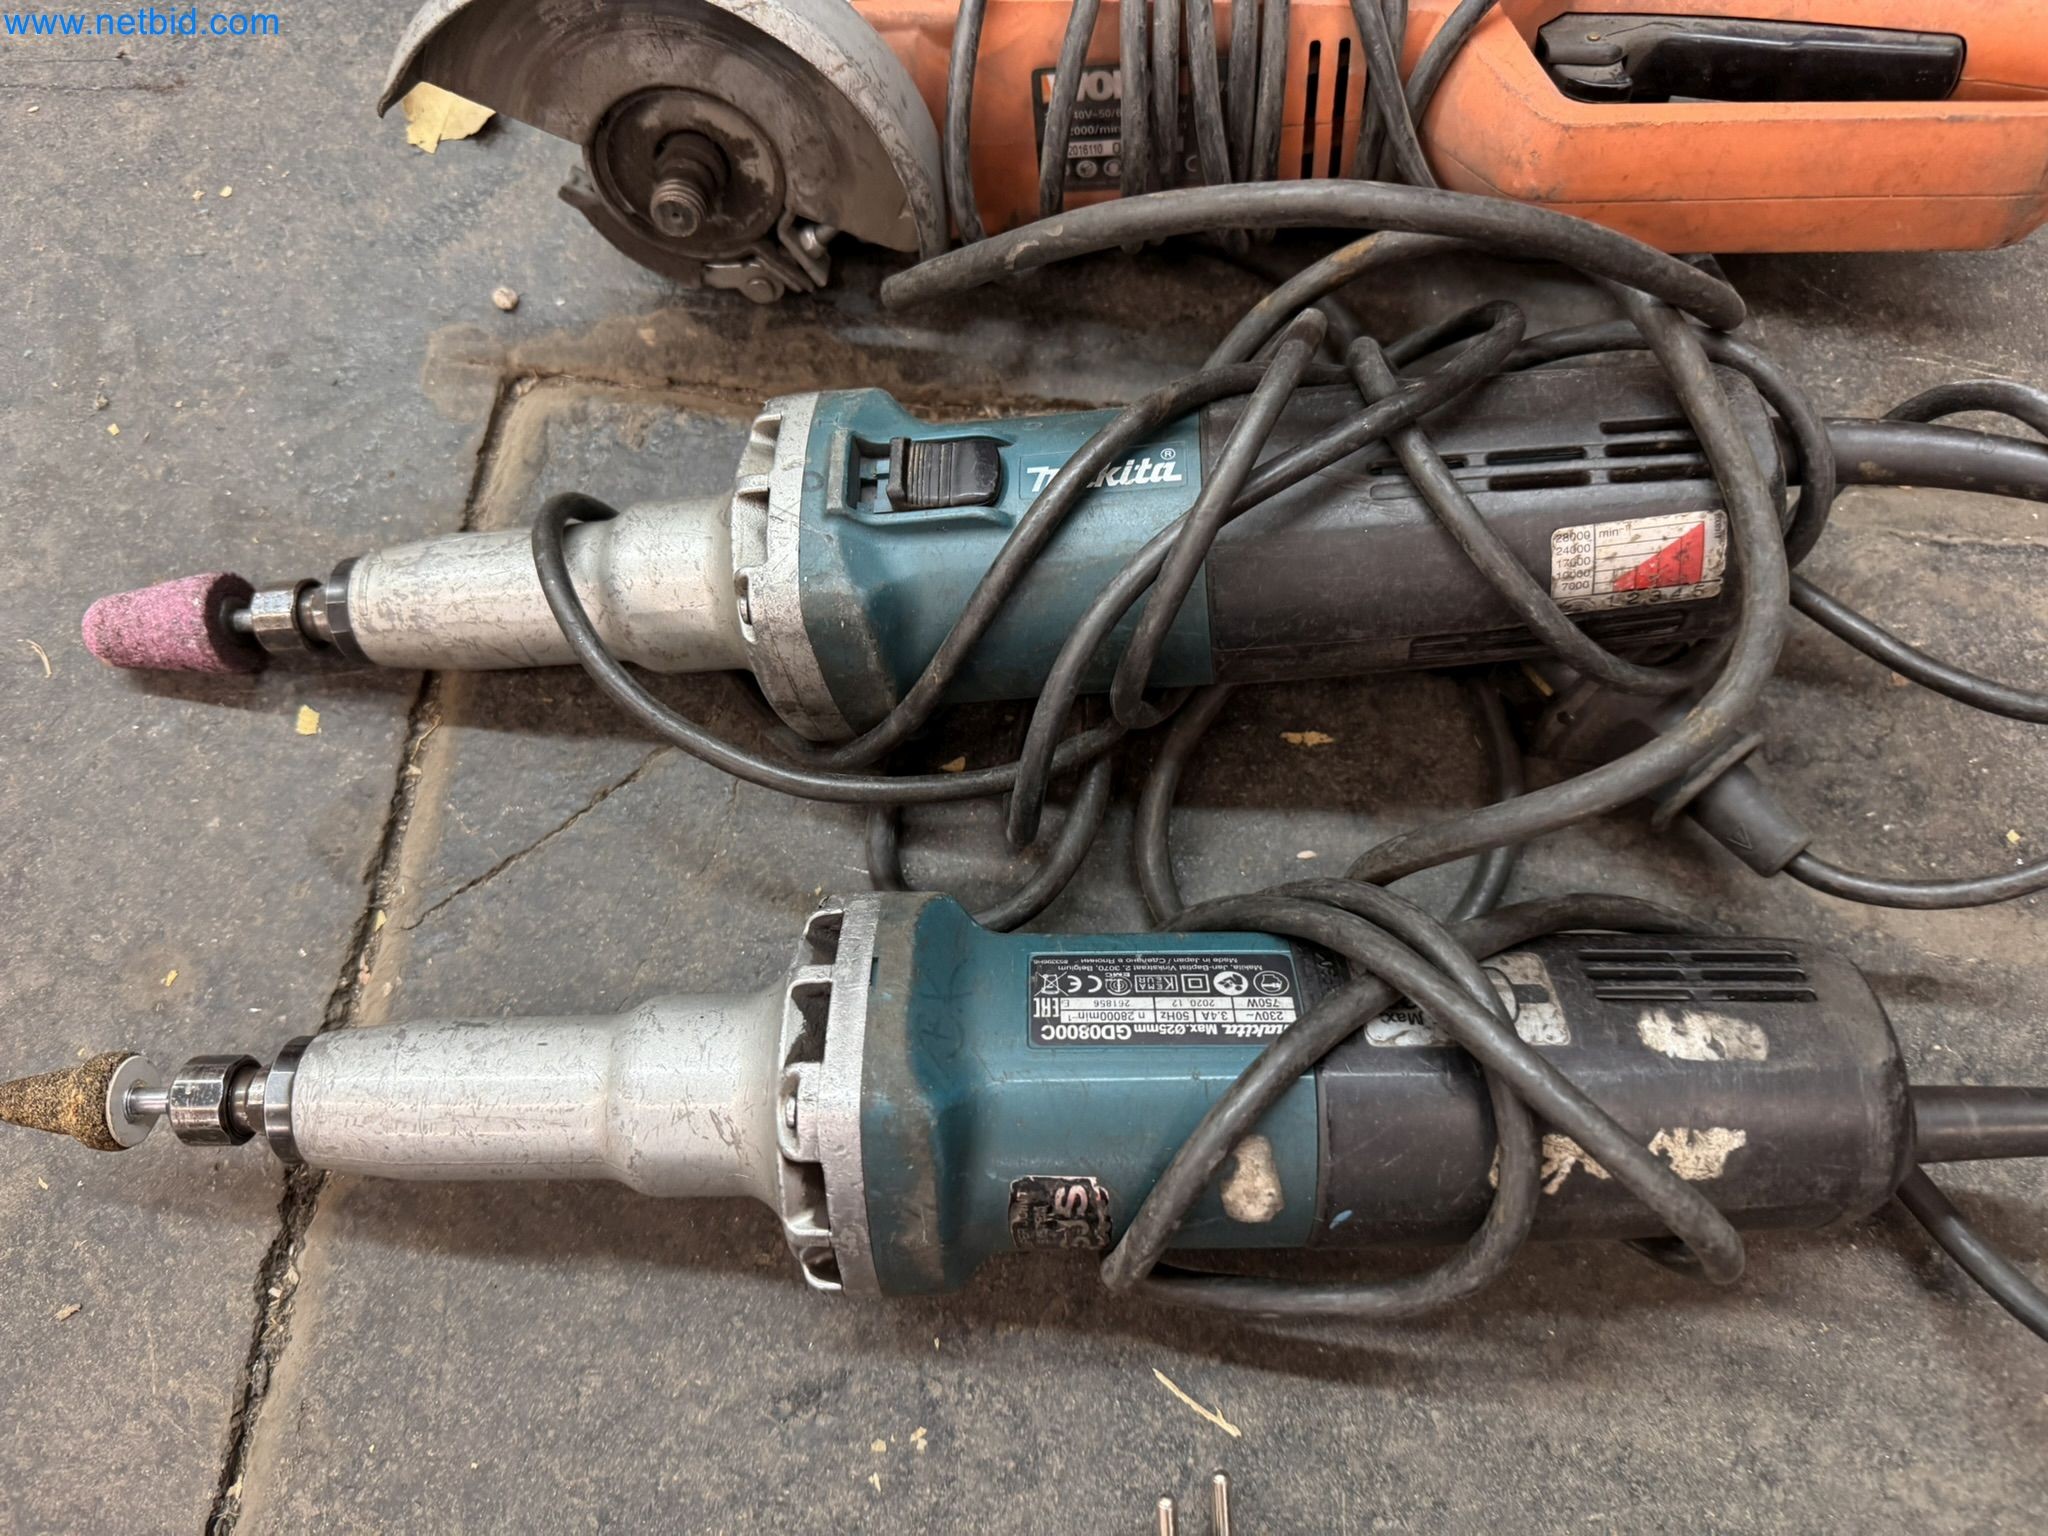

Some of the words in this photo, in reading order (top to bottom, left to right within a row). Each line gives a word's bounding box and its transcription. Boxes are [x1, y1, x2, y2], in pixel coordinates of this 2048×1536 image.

[1627, 592, 1641, 605] 2
[1651, 590, 1662, 602] 3
[1057, 964, 1094, 972] Belgium
[1093, 999, 1130, 1007] 261856
[1247, 999, 1281, 1008] 750W
[1160, 1010, 1190, 1021] 50Hz
[1201, 1011, 1229, 1021] 3.4A
[1041, 1024, 1132, 1040] GD0800C
